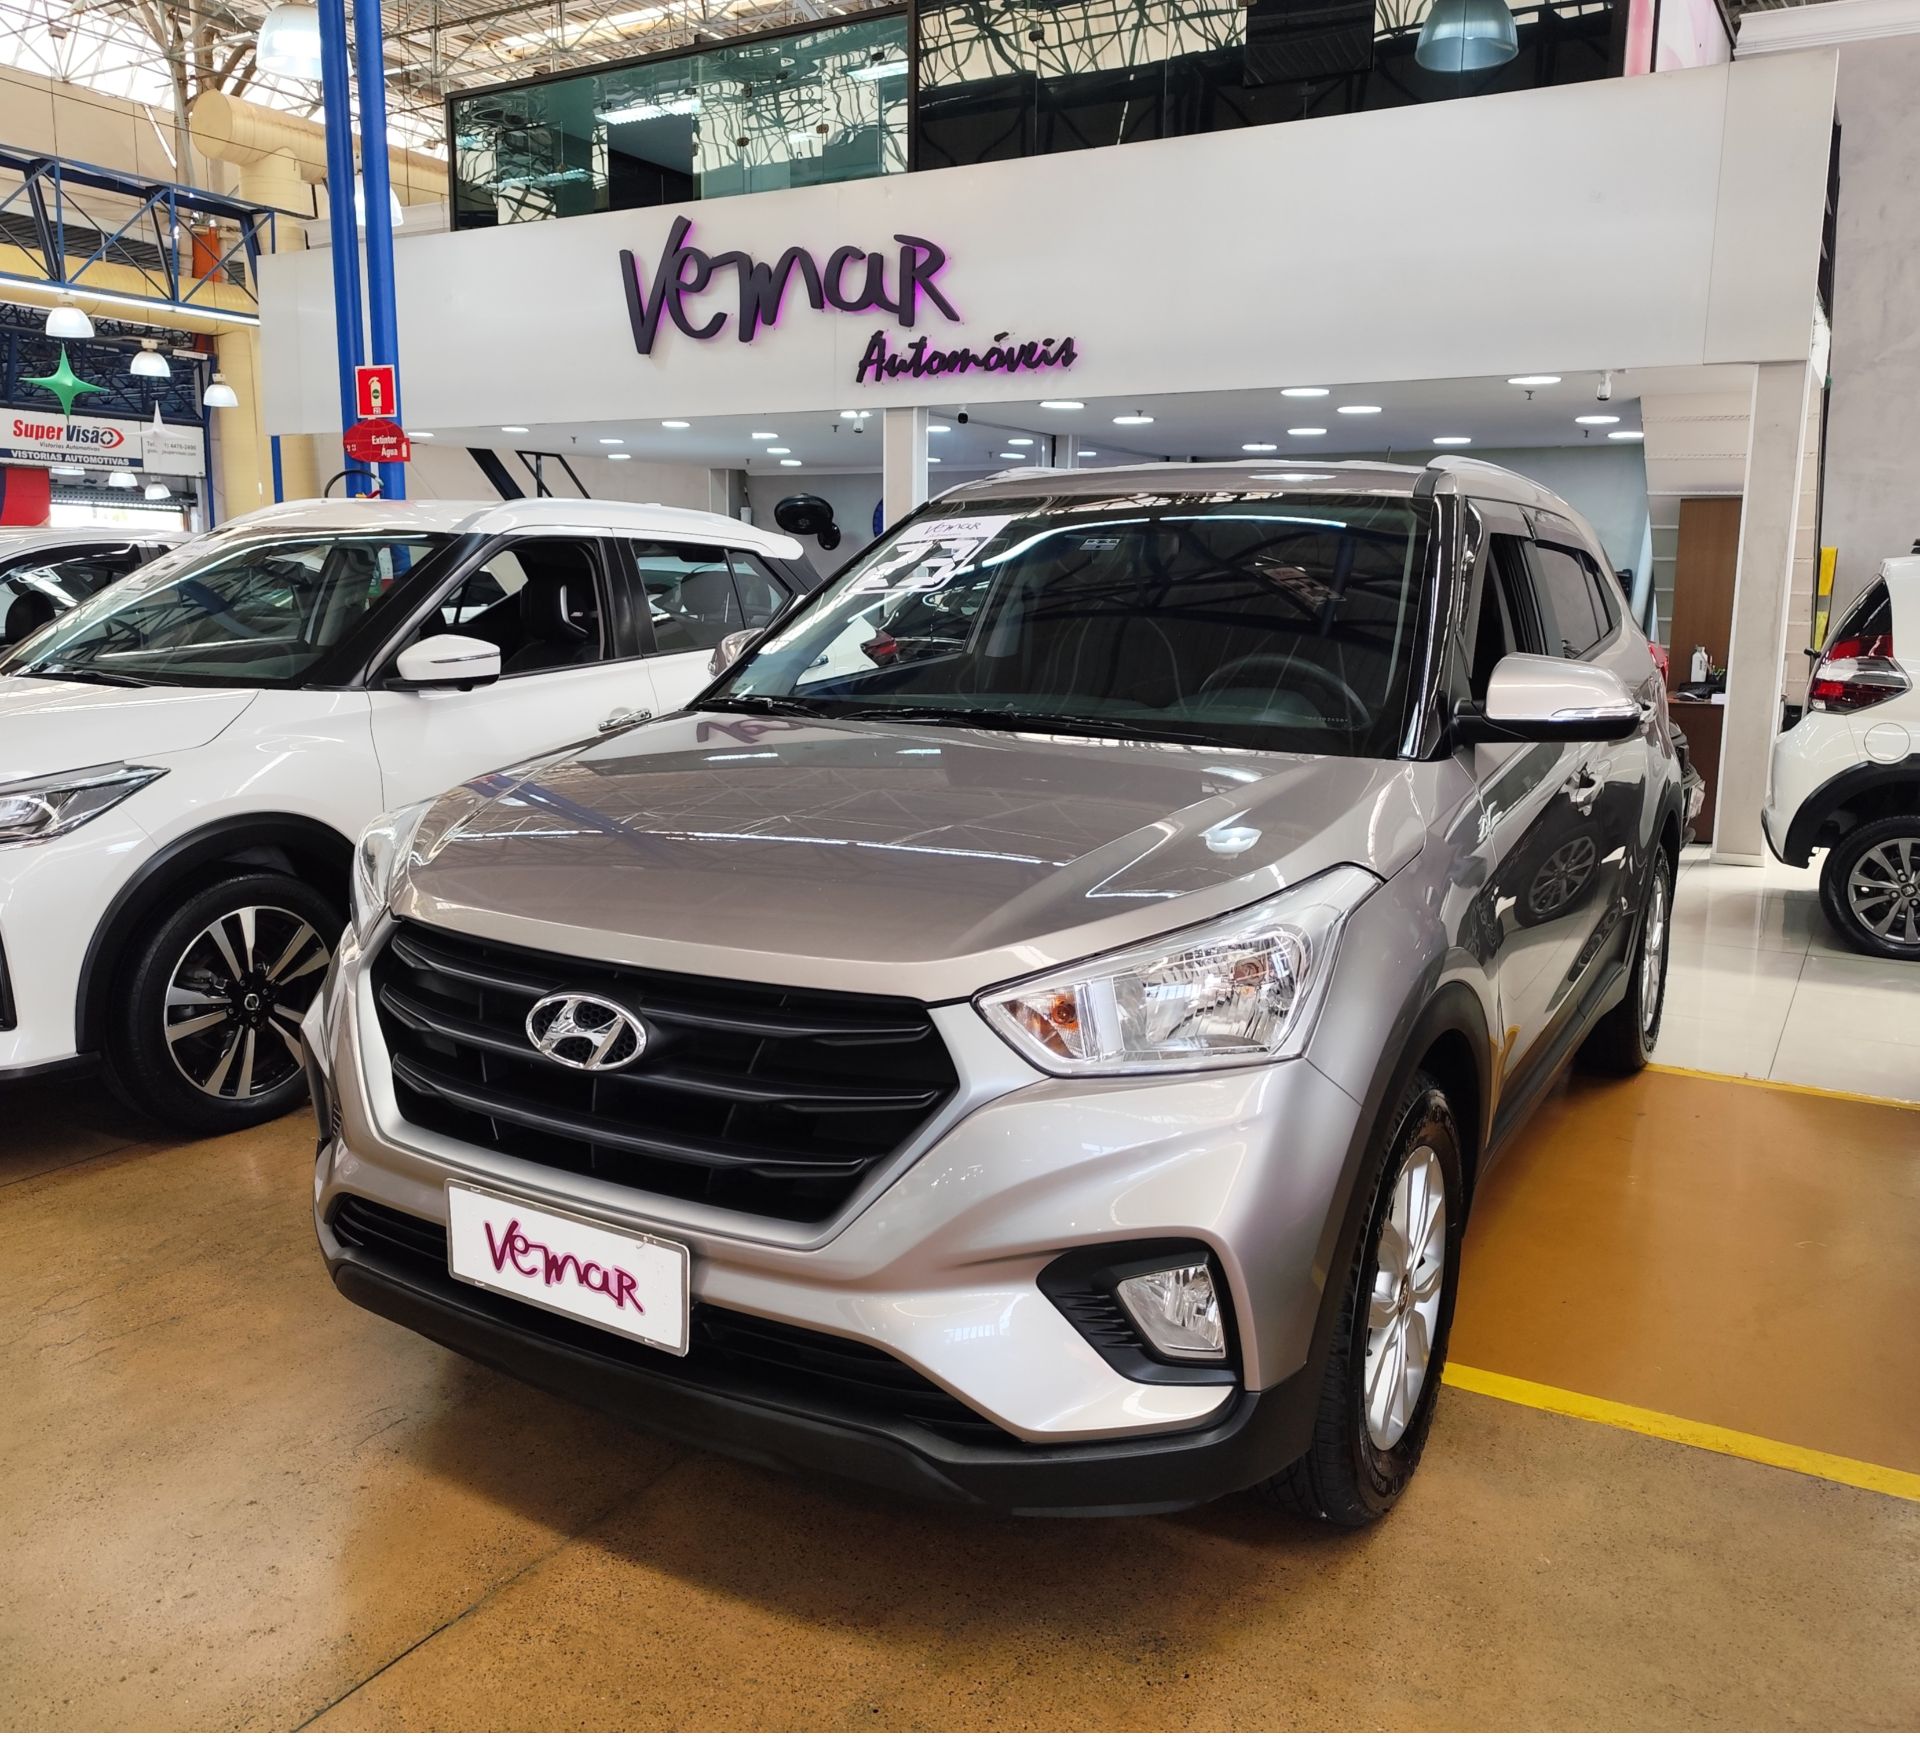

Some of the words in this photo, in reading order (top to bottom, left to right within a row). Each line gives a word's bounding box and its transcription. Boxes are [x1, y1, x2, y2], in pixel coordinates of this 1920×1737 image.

[856, 331, 1077, 384] Automóveis
[13, 419, 63, 440] Super
[371, 435, 397, 445] Extintor
[11, 450, 63, 461] VISTORIAS
[64, 455, 130, 466] AUTOMOTIVAS
[381, 444, 398, 458] Água
